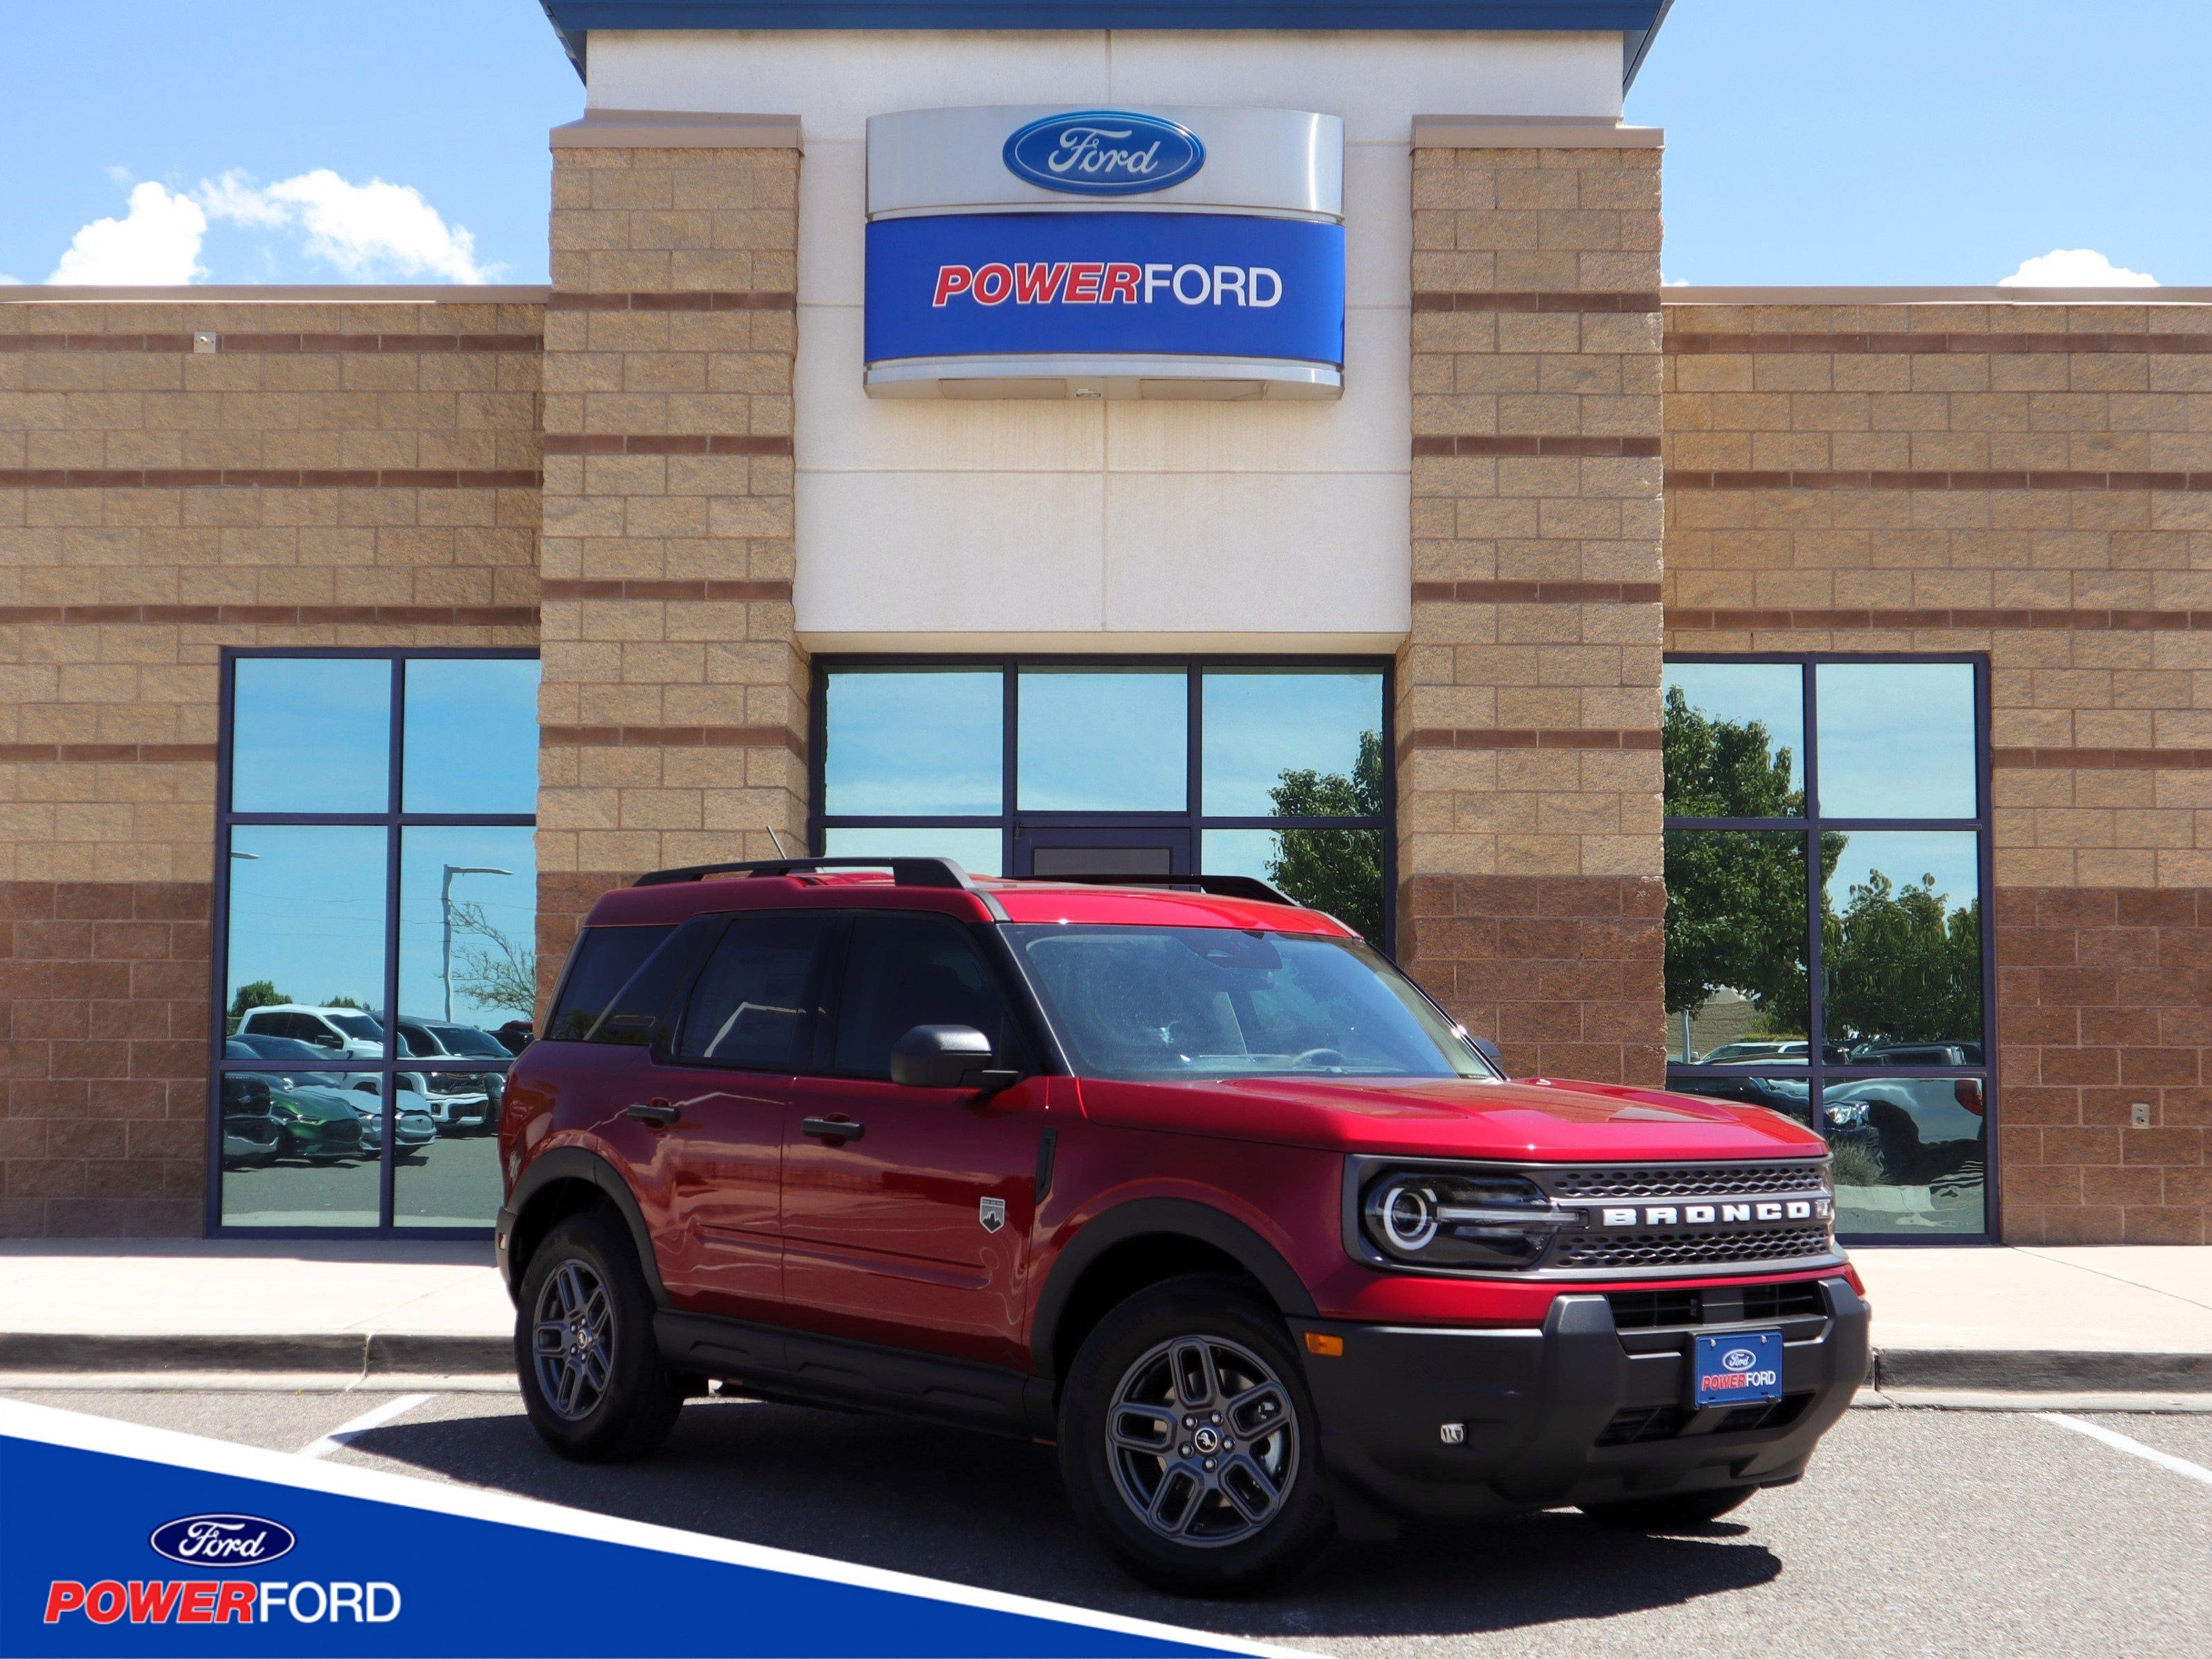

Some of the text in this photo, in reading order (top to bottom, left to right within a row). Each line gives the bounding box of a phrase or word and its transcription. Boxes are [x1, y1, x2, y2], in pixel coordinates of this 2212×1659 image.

[1048, 127, 1161, 173] Ford
[1602, 1201, 1811, 1226] BRONCO
[1729, 1352, 1750, 1367] Ford
